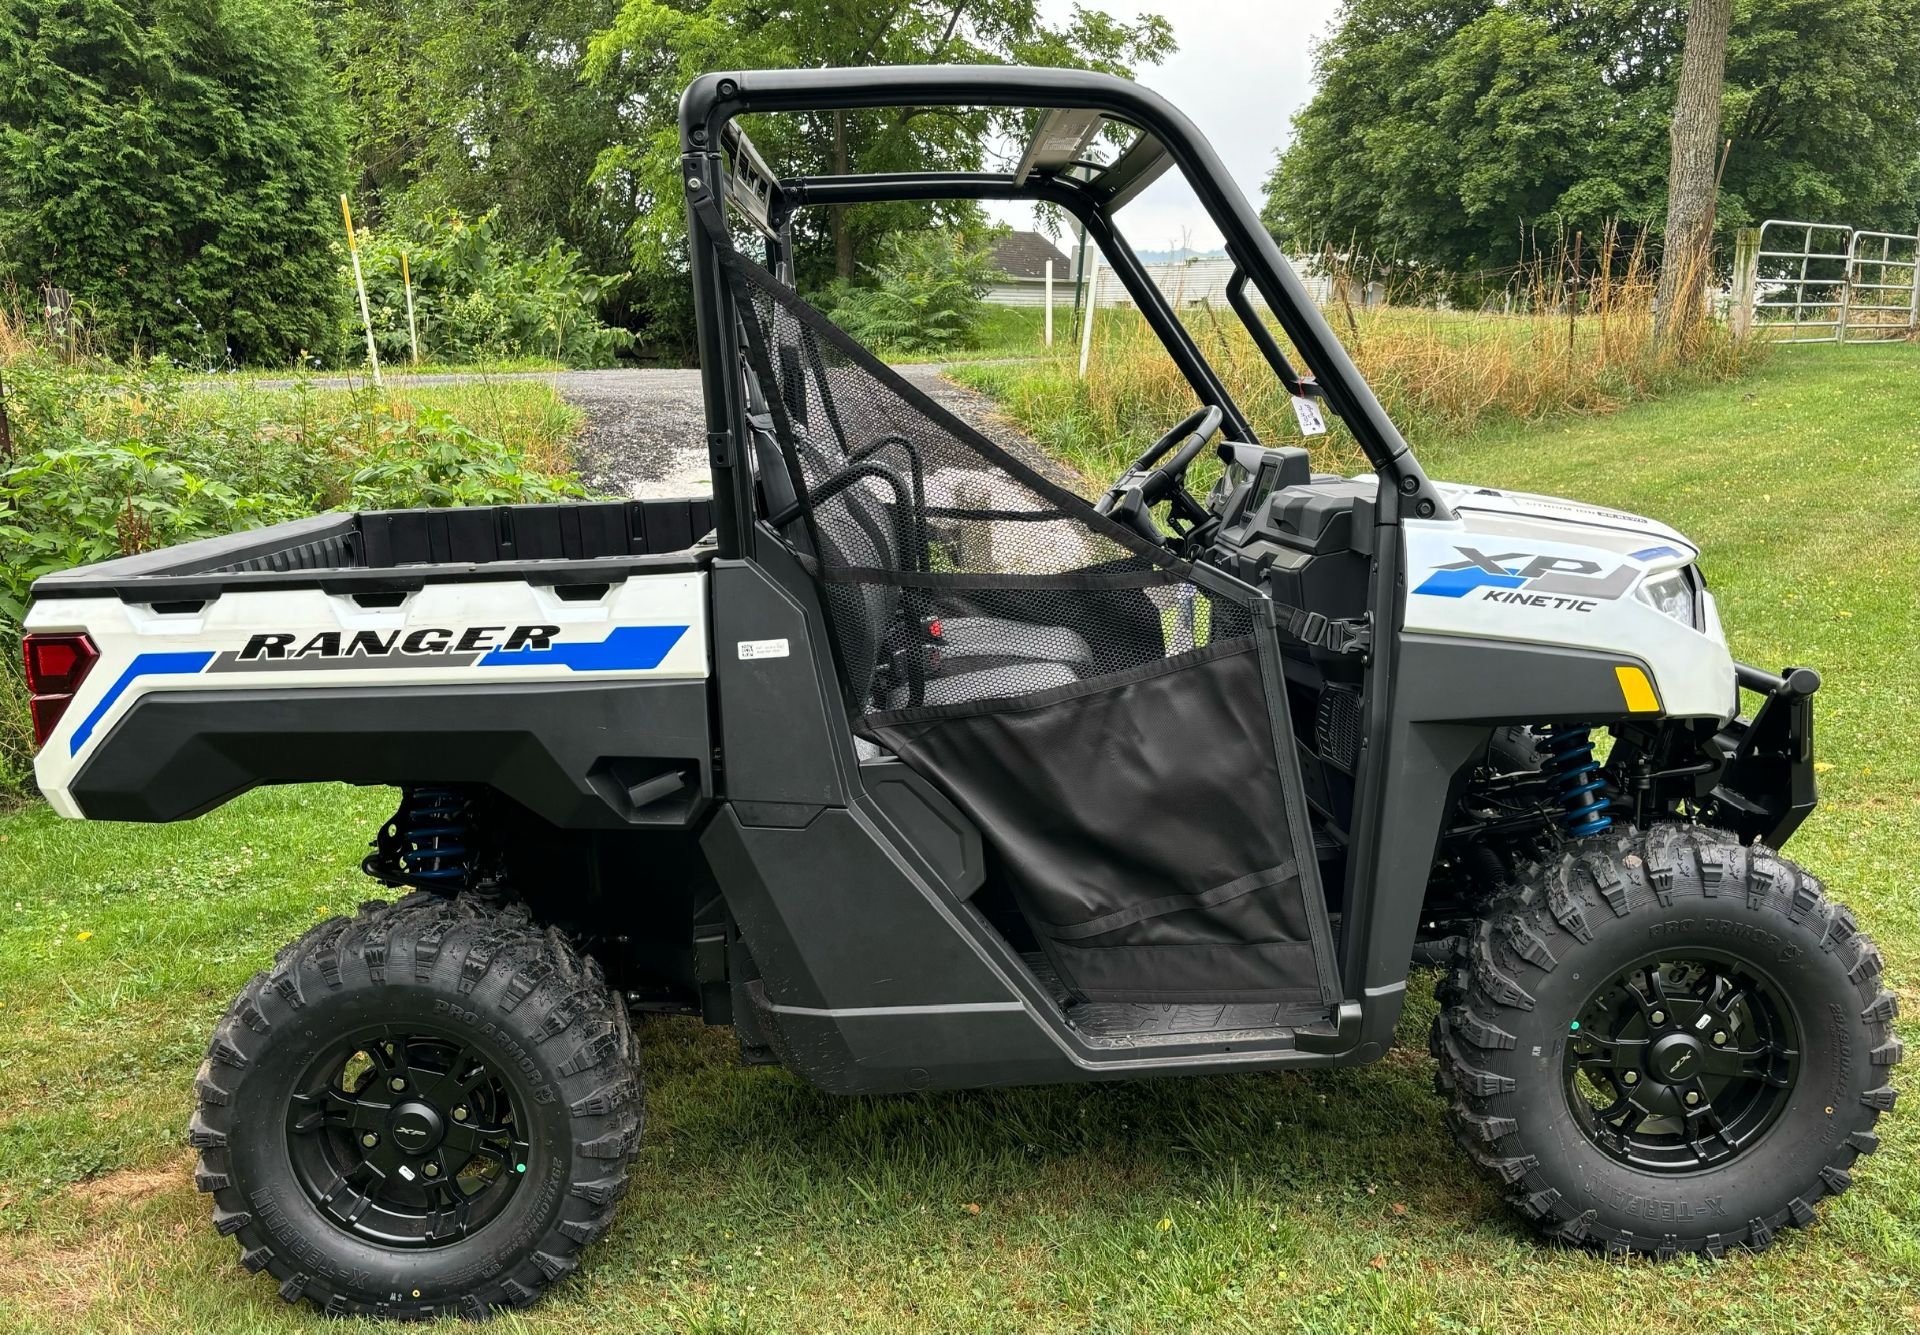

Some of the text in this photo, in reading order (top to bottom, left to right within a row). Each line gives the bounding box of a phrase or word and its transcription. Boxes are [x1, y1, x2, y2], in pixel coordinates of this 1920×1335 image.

[1429, 546, 1603, 579] XP
[1482, 590, 1598, 613] KINETIC
[238, 624, 561, 661] RANGER
[433, 998, 543, 1086] PRO ARMOR
[1669, 1049, 1692, 1074] XP
[395, 1126, 427, 1136] XP
[250, 1185, 370, 1290] X-TERRAIN
